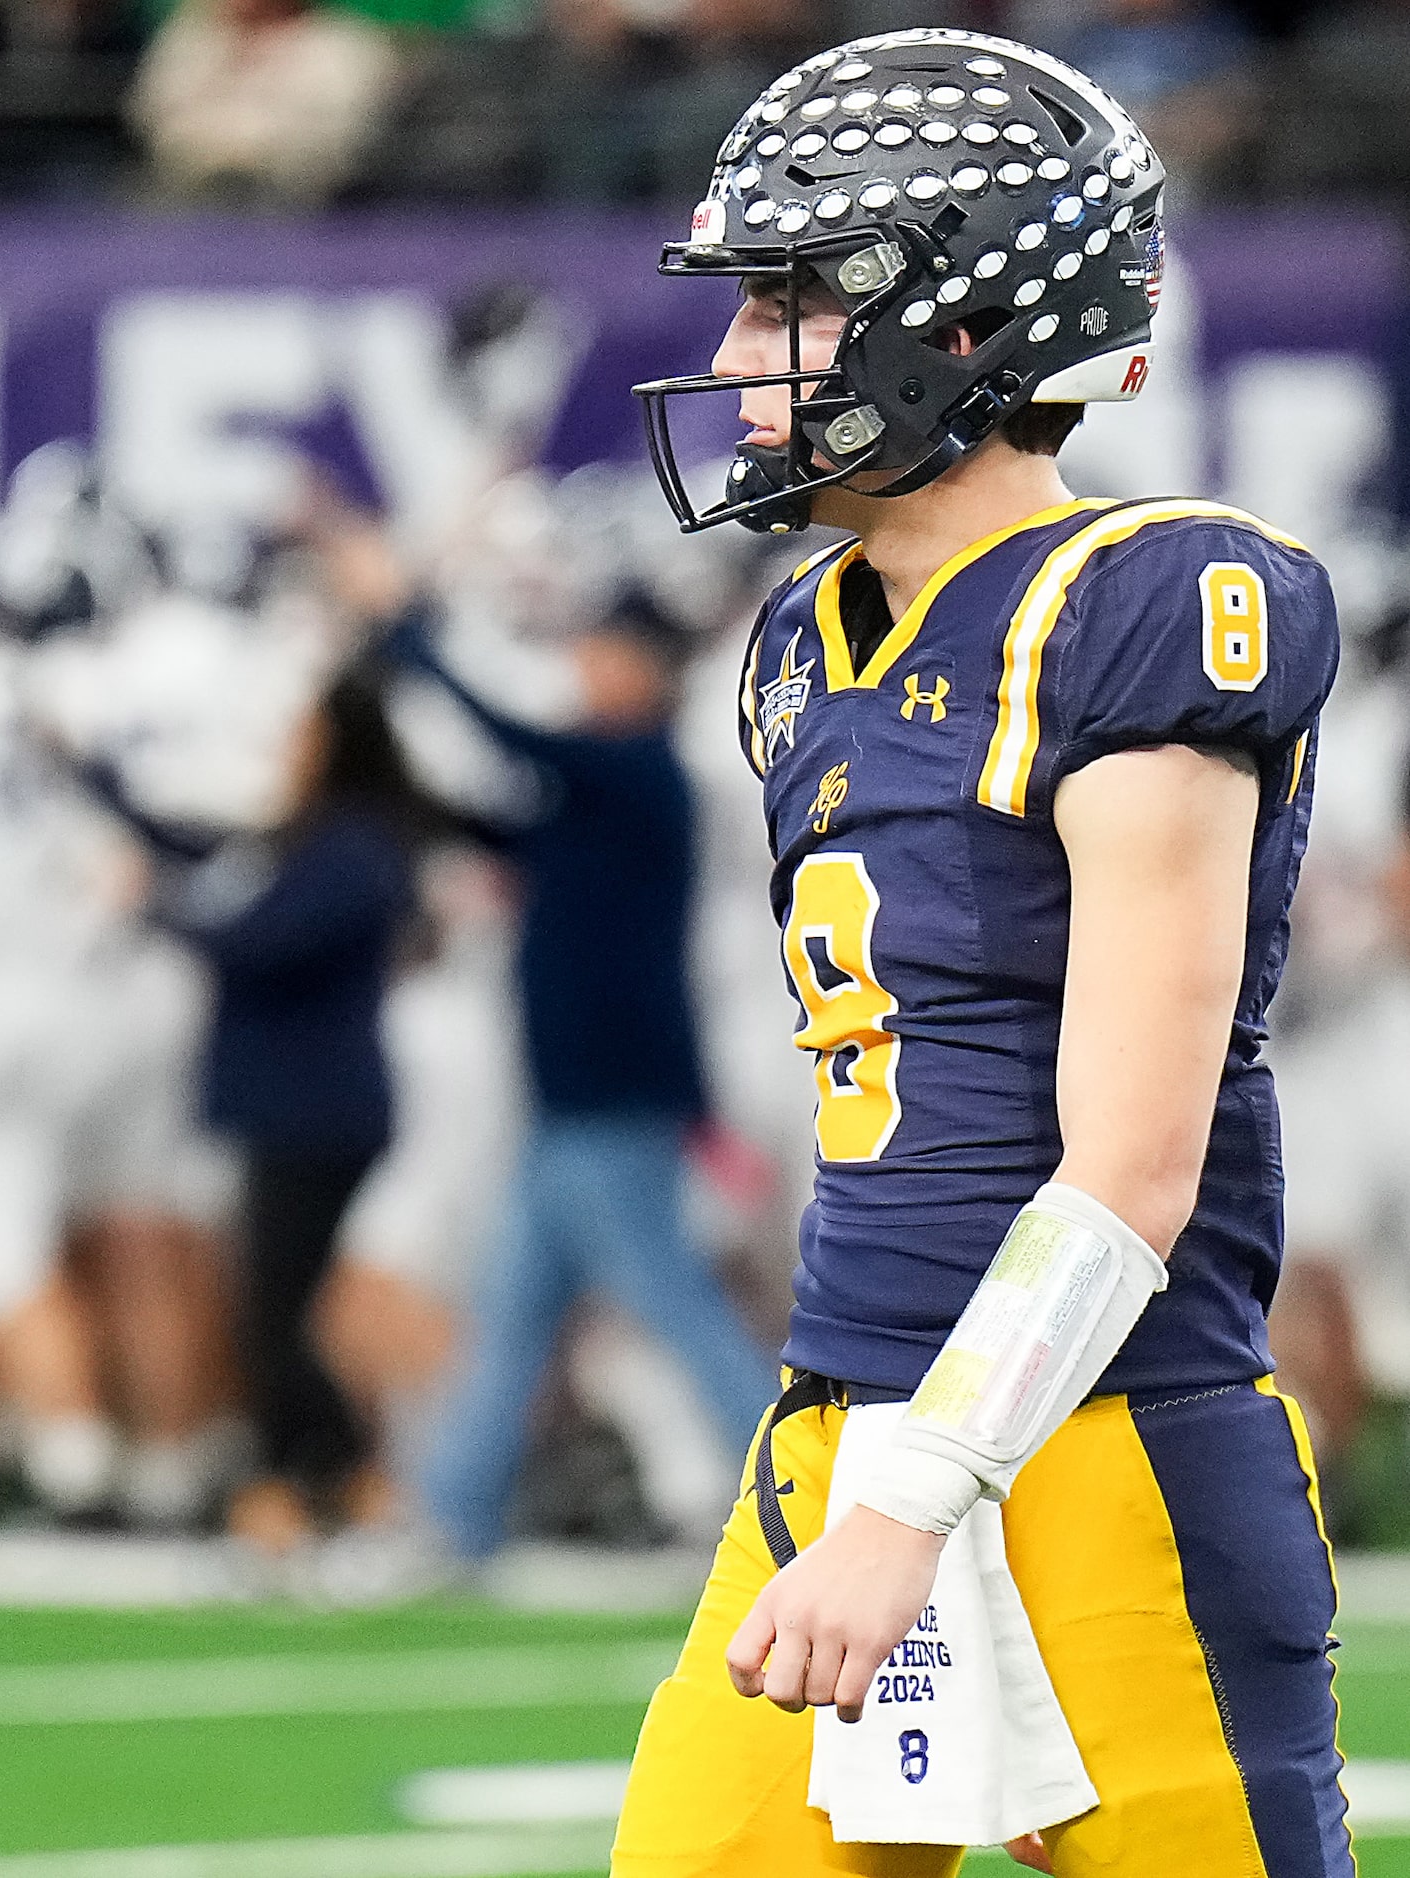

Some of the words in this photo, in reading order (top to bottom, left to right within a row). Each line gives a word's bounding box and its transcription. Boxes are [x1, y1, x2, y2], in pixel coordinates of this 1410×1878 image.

[1079, 306, 1110, 337] PRIDE
[1198, 561, 1269, 691] 8
[784, 851, 902, 1163] 8
[916, 1605, 938, 1632] OR
[887, 1638, 952, 1669] THING
[877, 1674, 935, 1704] 2024
[898, 1728, 929, 1784] 8
